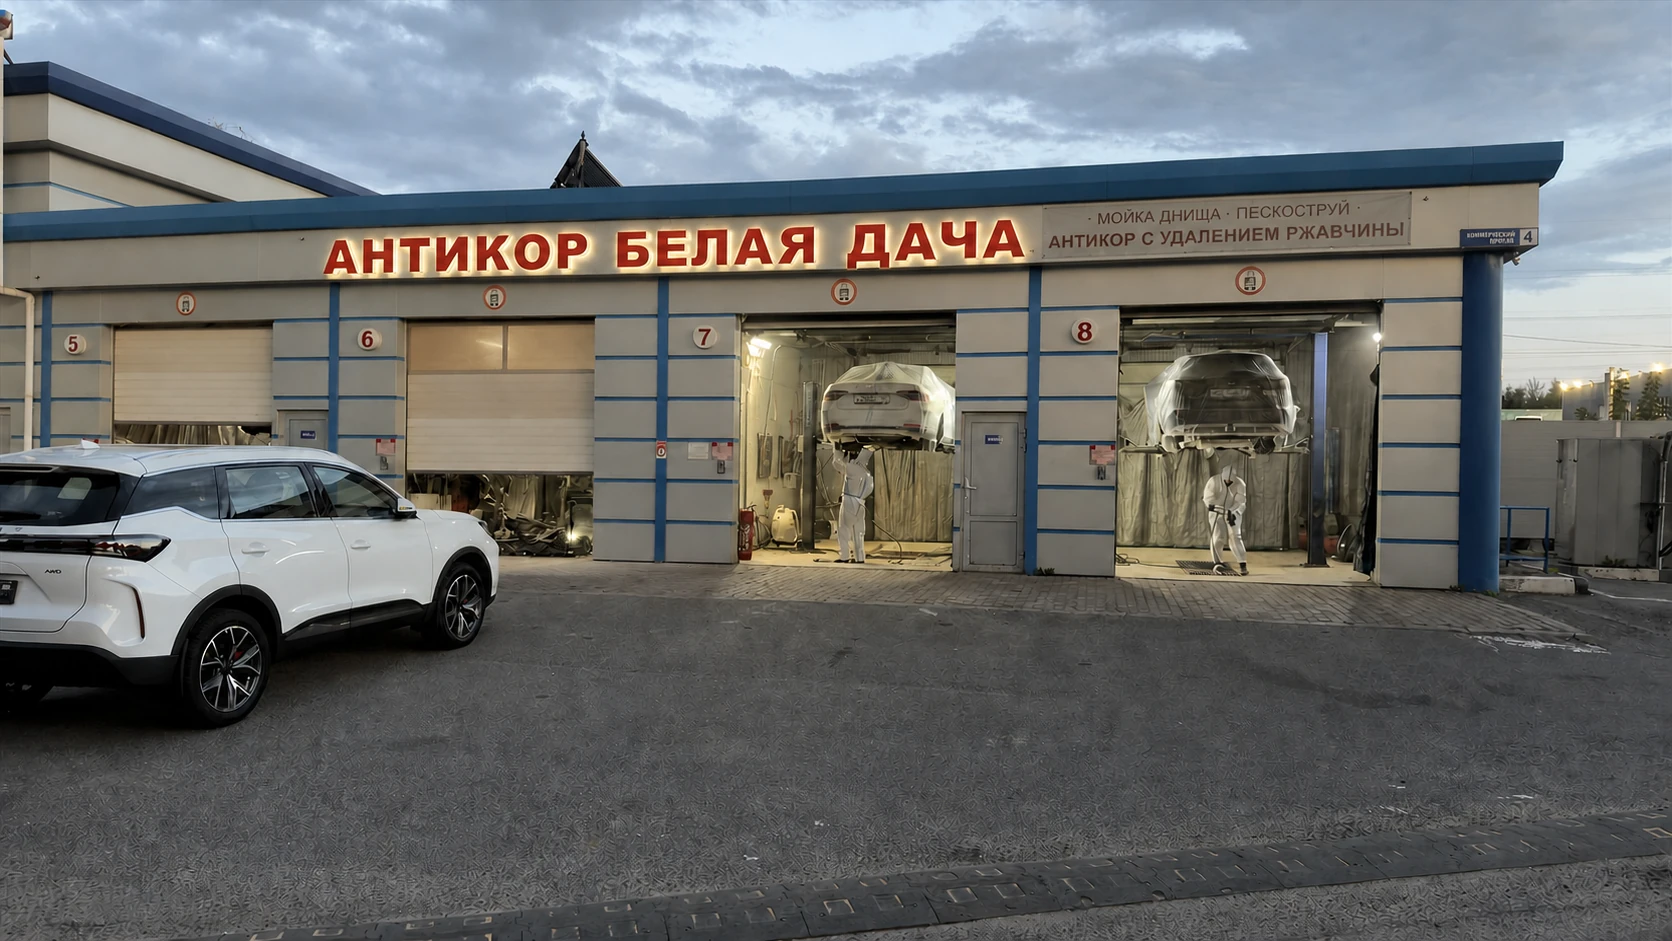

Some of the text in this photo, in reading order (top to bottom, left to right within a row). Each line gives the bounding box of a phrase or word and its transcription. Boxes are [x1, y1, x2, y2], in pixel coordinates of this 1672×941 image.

[1097, 200, 1350, 225] МОЙКА ДНИЩА ПЕСКОСТРУЙ
[1048, 221, 1405, 249] АНТИКОР С УДАЛЕНИЕМ РЖАВЧИНЫ
[1523, 230, 1533, 243] 4
[323, 219, 1026, 275] АНТИКОР БЕЛАЯ ДАЧА
[361, 330, 374, 348] 6
[698, 328, 712, 346] 7
[1077, 321, 1093, 342] 8
[68, 335, 78, 353] 5
